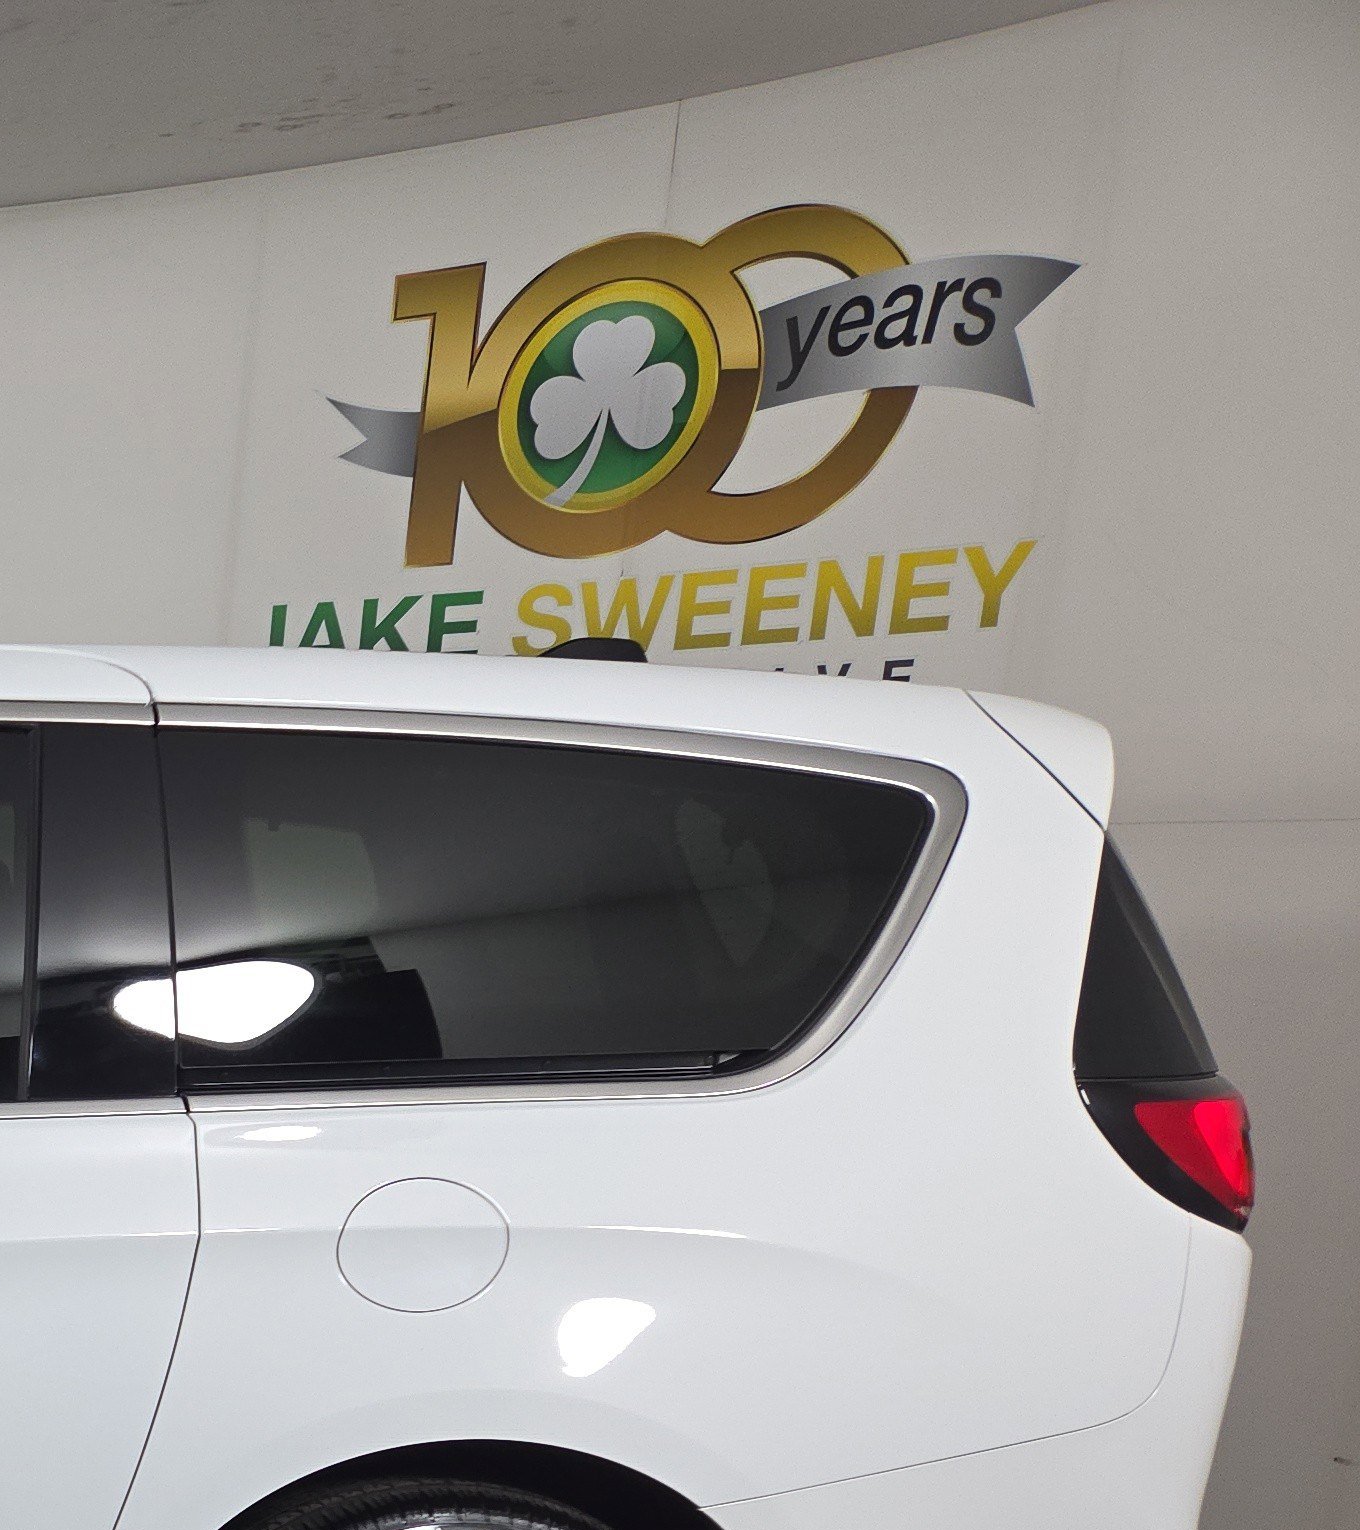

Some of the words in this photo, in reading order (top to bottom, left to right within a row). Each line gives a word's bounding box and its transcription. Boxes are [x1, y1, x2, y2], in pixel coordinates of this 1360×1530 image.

[391, 203, 921, 568] 100
[776, 275, 1002, 390] years
[512, 540, 1037, 659] SWEENEY
